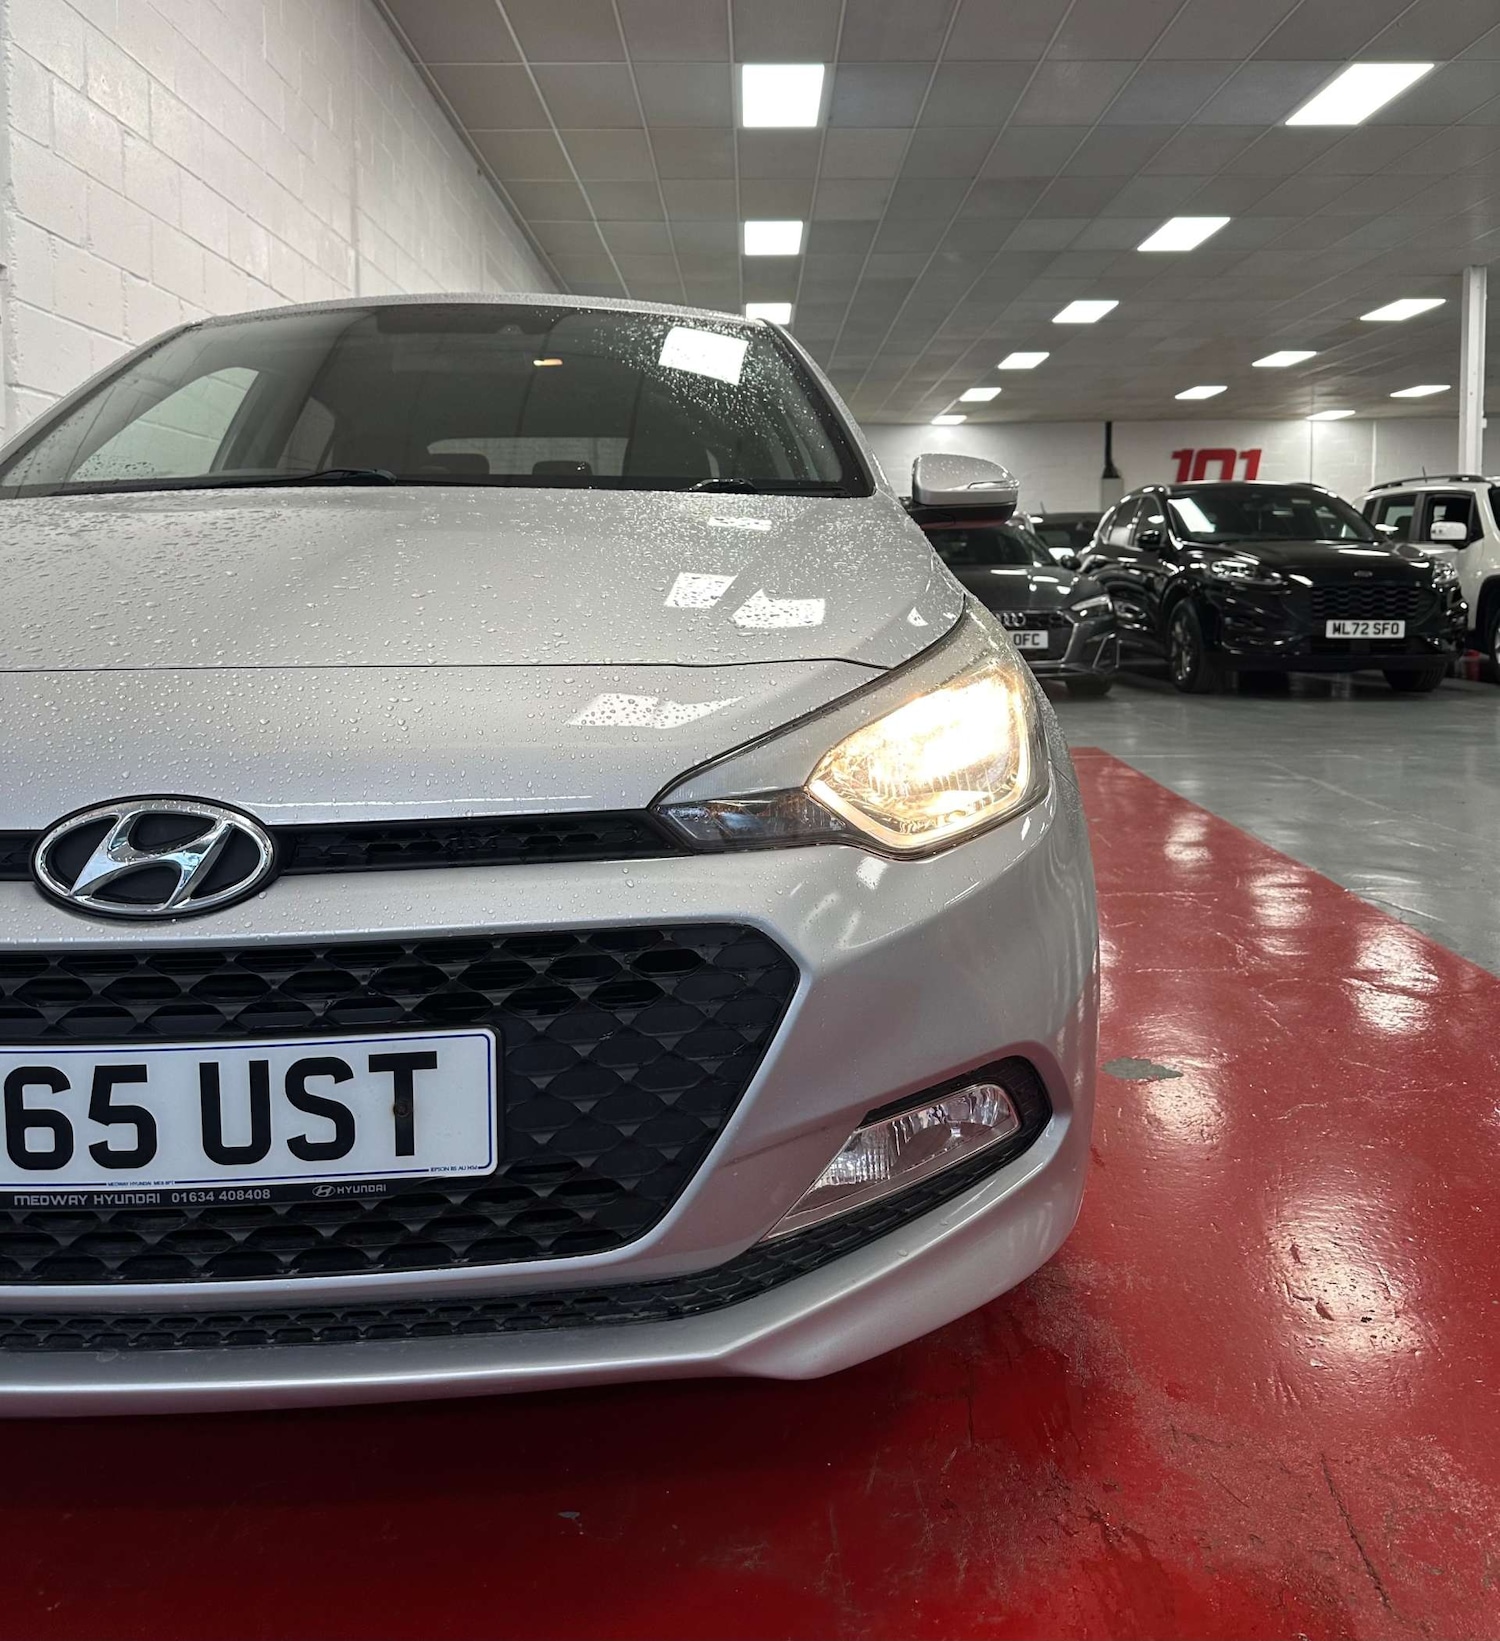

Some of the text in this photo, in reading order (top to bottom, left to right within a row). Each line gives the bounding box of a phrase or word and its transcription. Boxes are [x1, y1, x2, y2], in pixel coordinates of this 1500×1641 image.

[1171, 448, 1262, 483] 101
[1332, 622, 1399, 635] ML72 SFO
[1013, 633, 1040, 646] OFC
[4, 1051, 438, 1170] 65 UST
[336, 1184, 387, 1194] HYUNDAI
[14, 1189, 271, 1206] MEDWAY HYUNDAI 01634 408408
